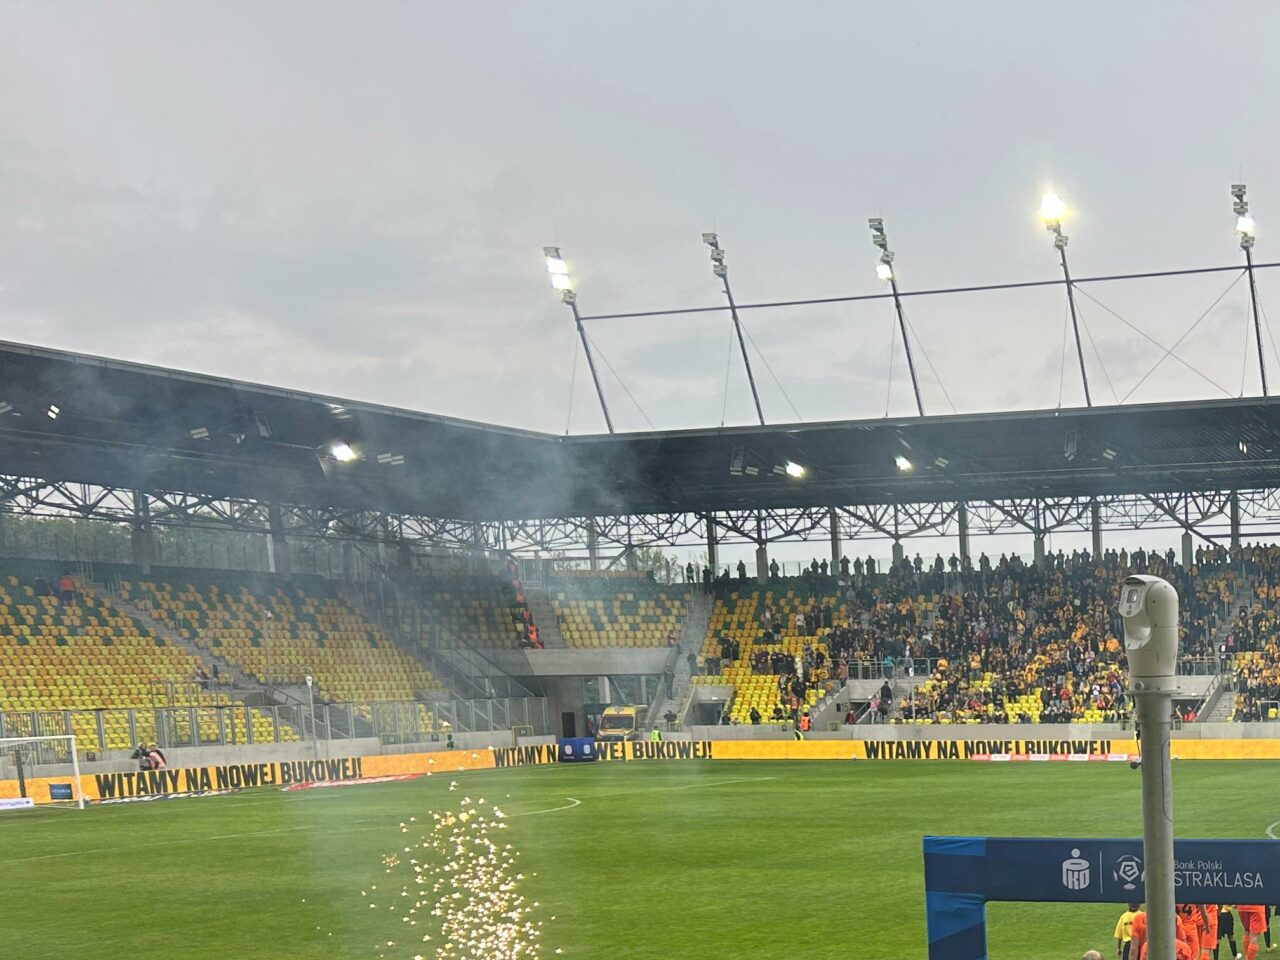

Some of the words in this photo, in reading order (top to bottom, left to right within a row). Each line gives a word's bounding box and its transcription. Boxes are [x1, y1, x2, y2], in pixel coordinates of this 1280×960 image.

[494, 744, 543, 767] WITAMY
[547, 745, 556, 763] N
[633, 741, 712, 760] BUKOWEJ!
[864, 740, 931, 759] WITAMY
[937, 740, 958, 759] NA
[1025, 740, 1111, 754] BUKOWEJ!
[95, 770, 181, 799] WITAMY
[185, 767, 210, 791] NA
[216, 763, 275, 788] NOWEJ
[281, 757, 361, 785] BUKOWEJ!
[1198, 861, 1222, 870] Polski
[1174, 872, 1264, 888] STRAKLASA
